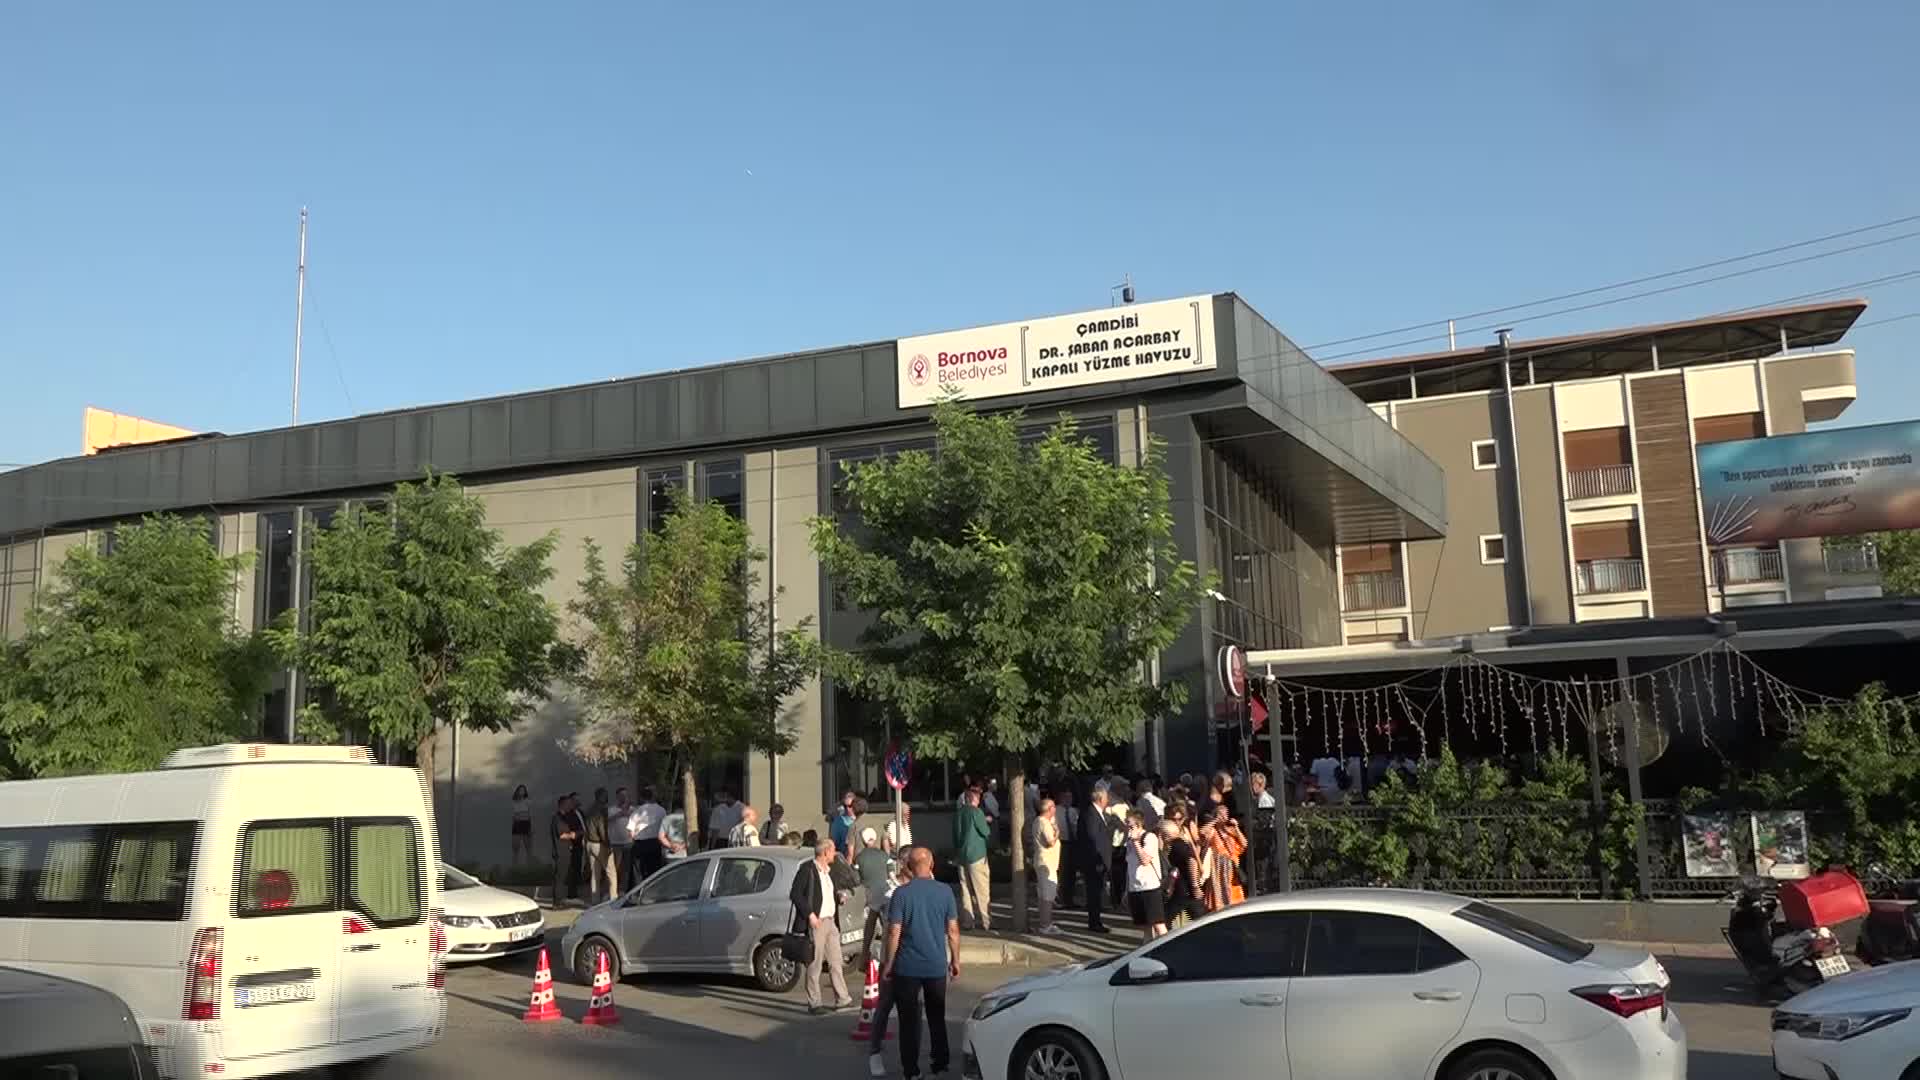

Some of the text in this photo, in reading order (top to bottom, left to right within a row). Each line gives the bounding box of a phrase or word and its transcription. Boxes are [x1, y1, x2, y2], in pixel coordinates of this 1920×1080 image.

[1076, 313, 1139, 337] ÇAMDİBİ
[1040, 329, 1181, 360] DR. ŞABAN ACARBAY
[938, 347, 1007, 367] Bornova
[1032, 347, 1191, 379] KAPALI YÜZME HAVUZU
[938, 362, 1007, 383] Belediyesi
[1811, 461, 1836, 474] çevik
[1838, 461, 1849, 470] ve
[1872, 453, 1913, 467] zamanda
